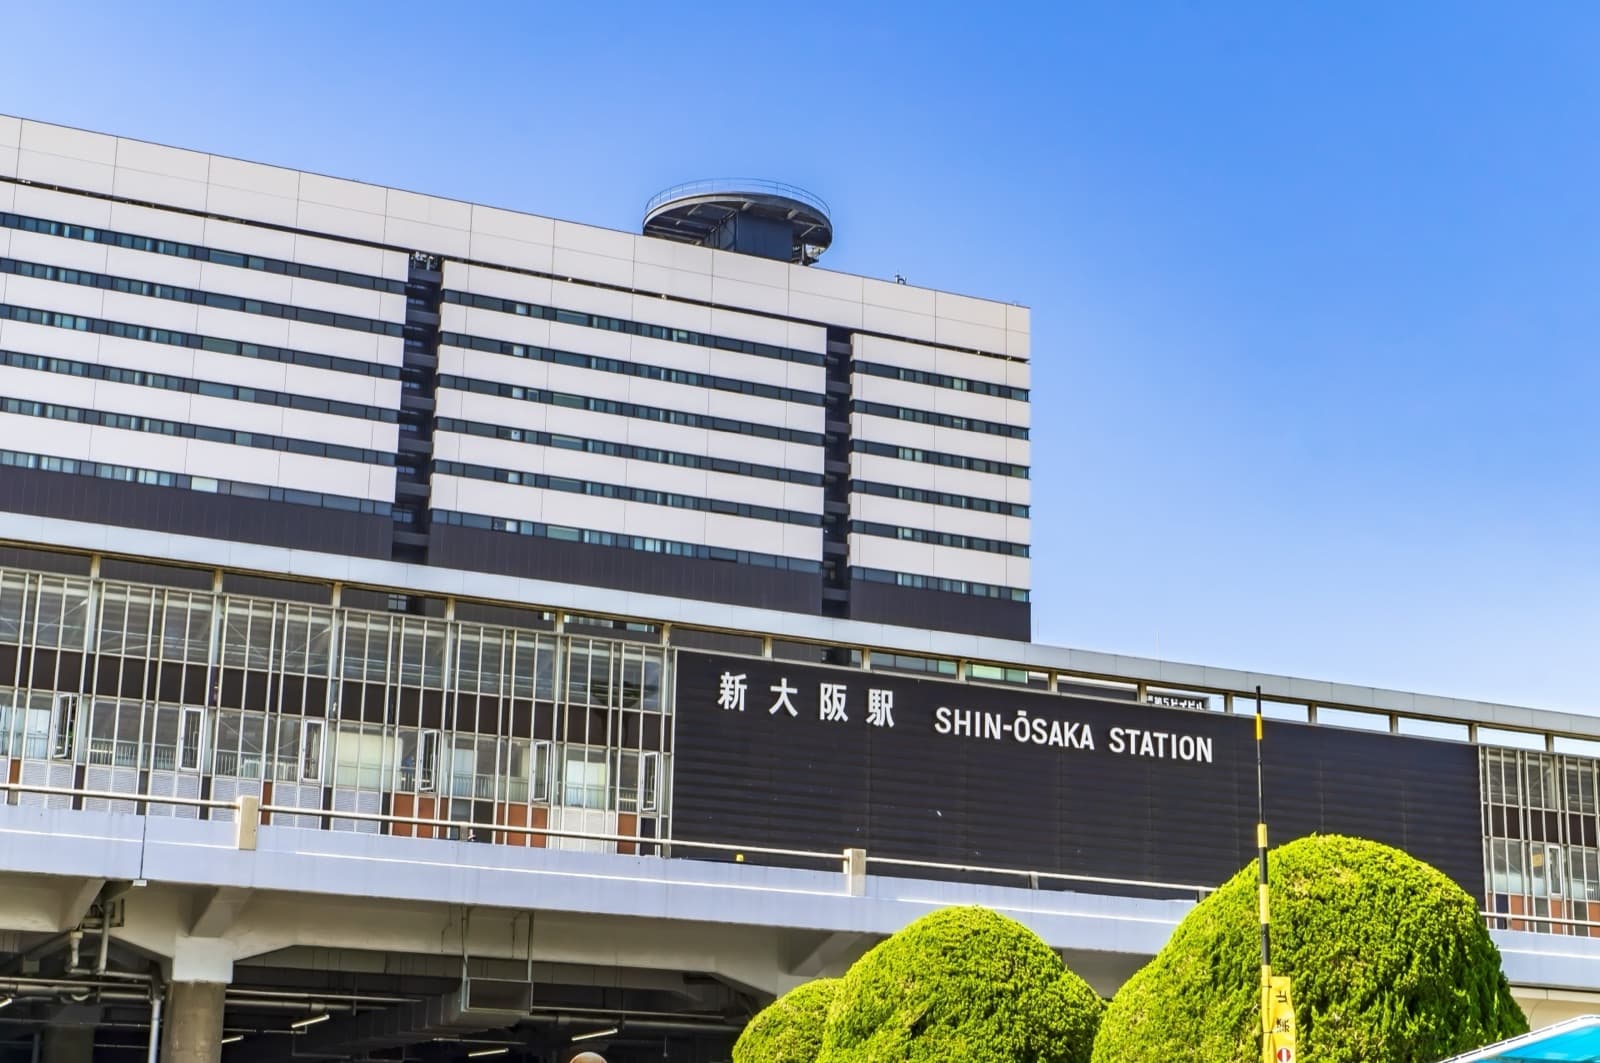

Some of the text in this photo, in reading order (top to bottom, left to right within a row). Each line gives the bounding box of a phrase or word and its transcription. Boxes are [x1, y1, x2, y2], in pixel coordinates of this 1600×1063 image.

[717, 671, 896, 729] 新大阪駅
[934, 707, 1214, 764] SHIN-ŌSAKA STATION
